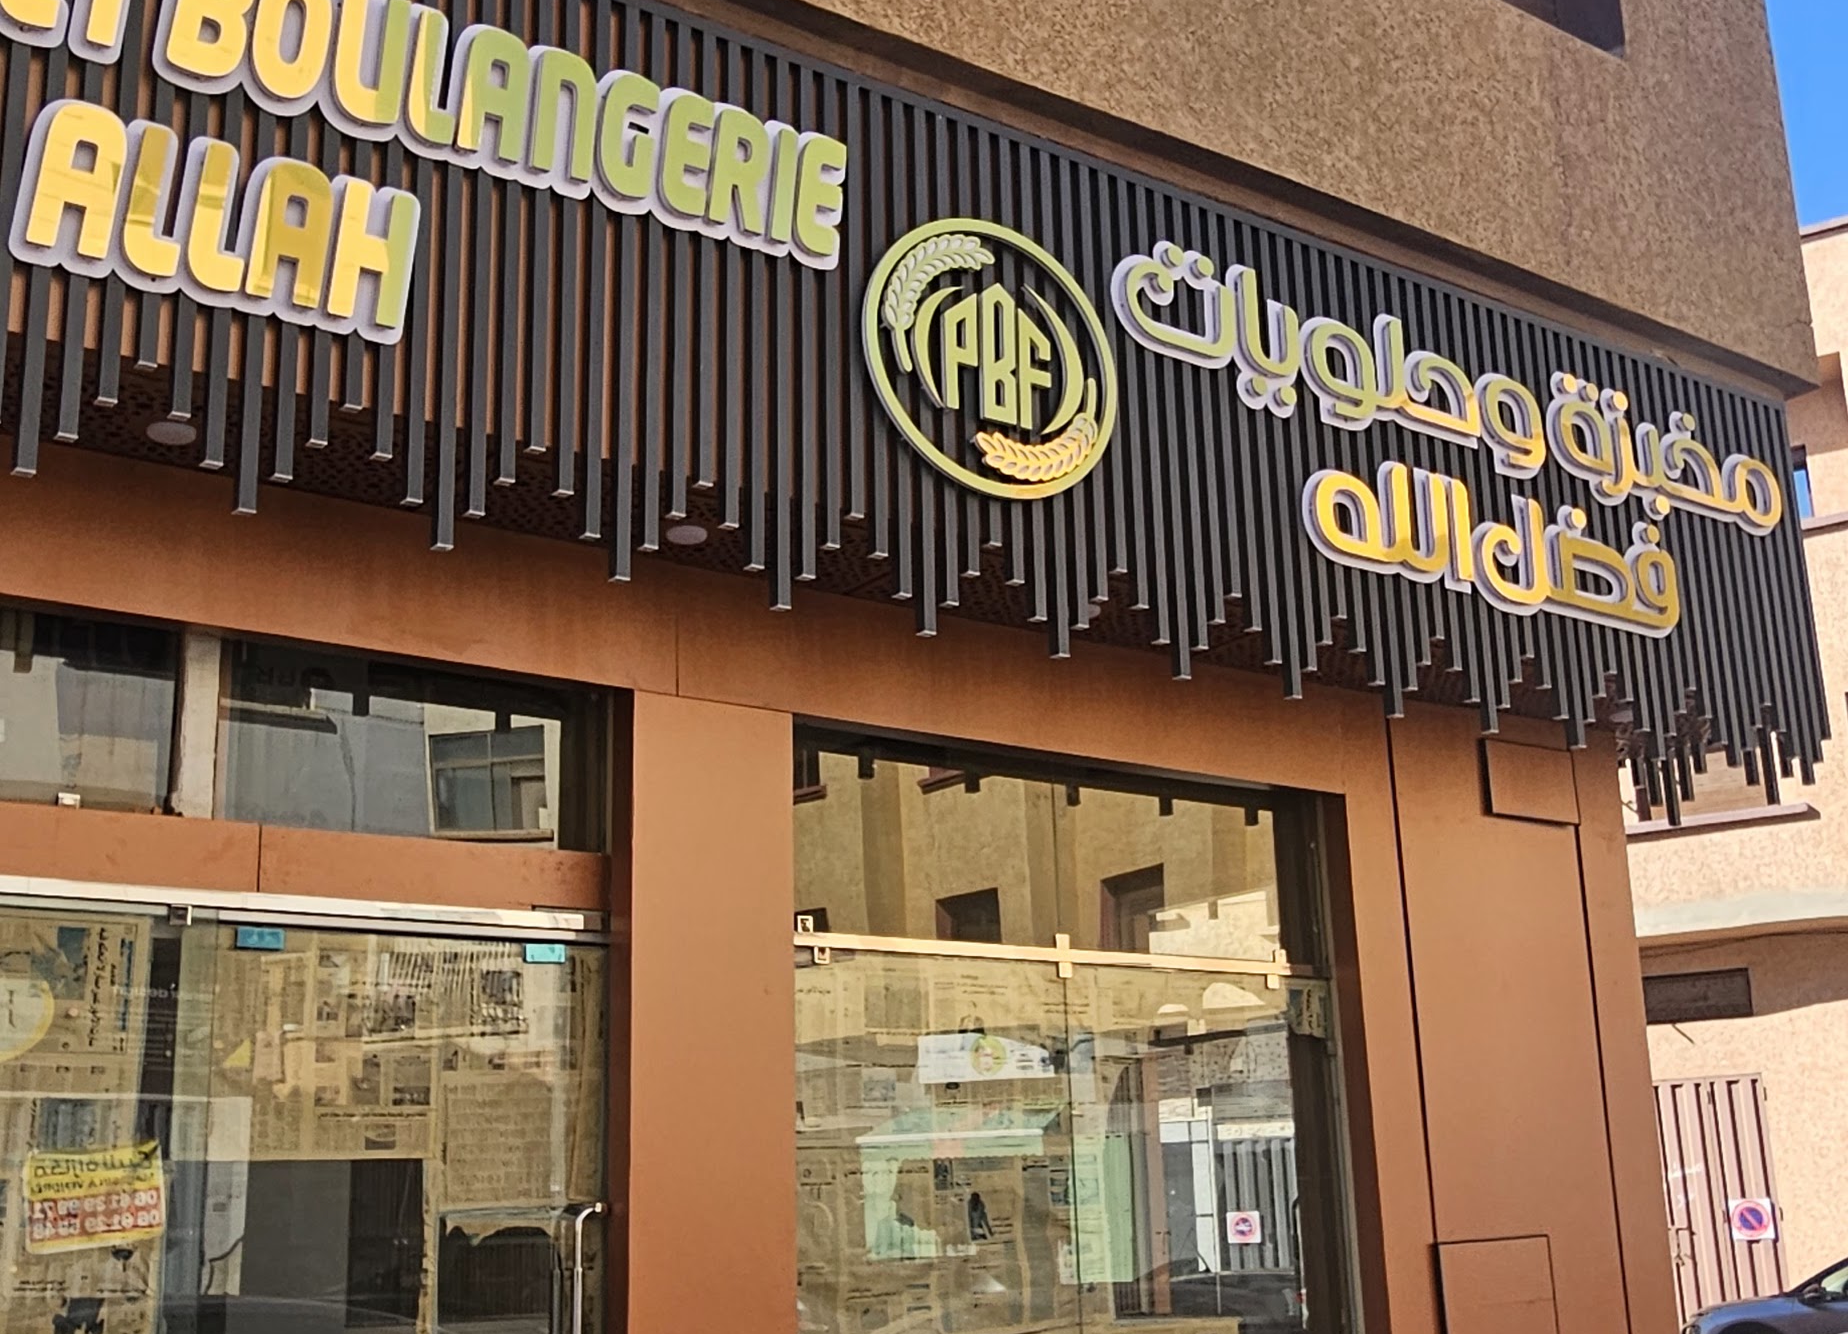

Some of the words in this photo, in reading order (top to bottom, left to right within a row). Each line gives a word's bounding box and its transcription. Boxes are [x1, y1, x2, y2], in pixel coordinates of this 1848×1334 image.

[18, 101, 414, 334] ALLAH
[941, 282, 1053, 431] PBF
[1114, 242, 1547, 475] وحلويات
[1306, 461, 1475, 589] الله
[1550, 372, 1782, 532] مخبزة
[1475, 496, 1681, 633] فضل
